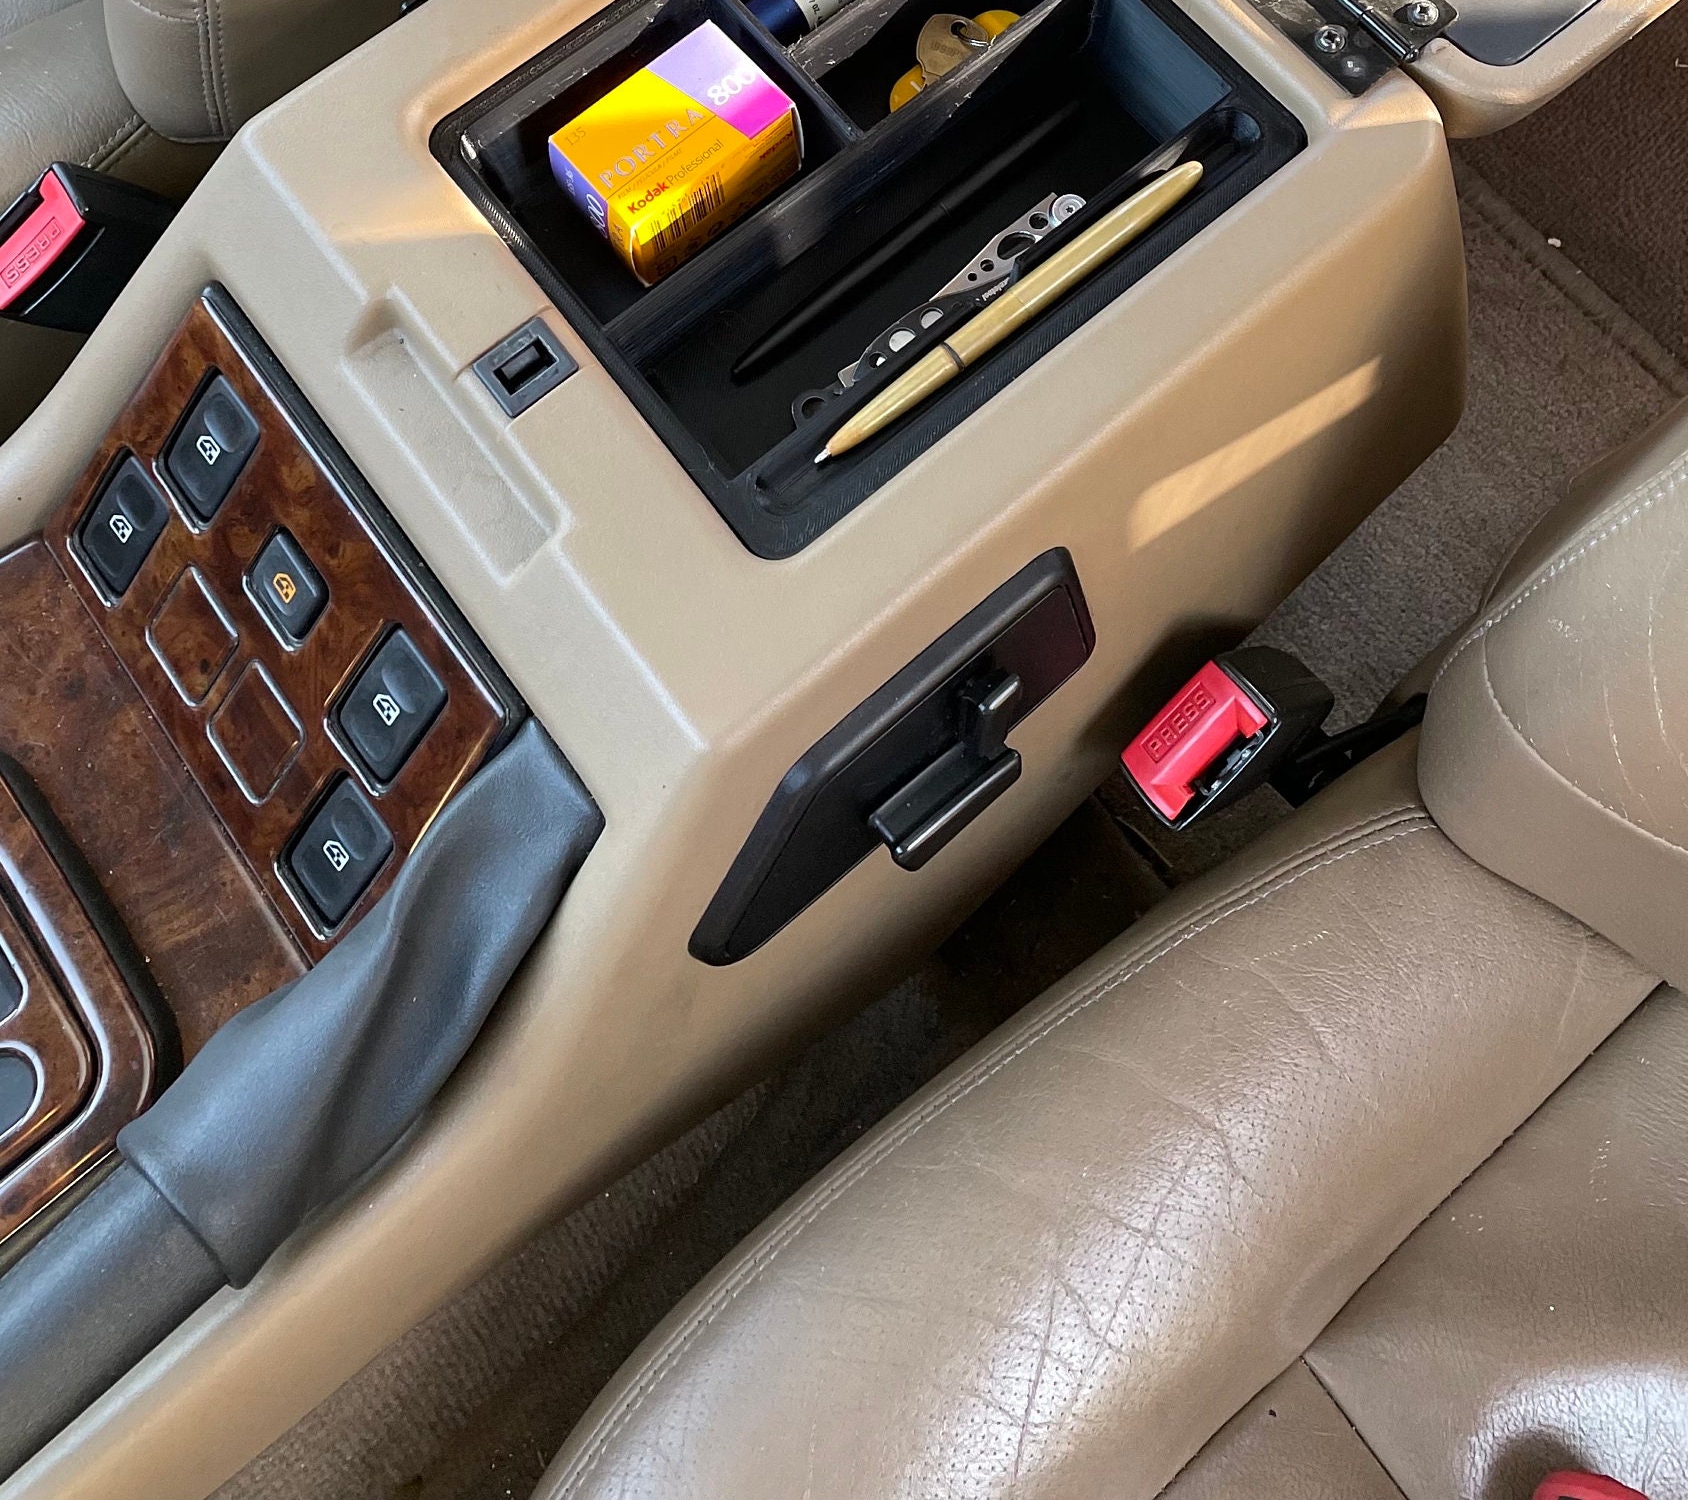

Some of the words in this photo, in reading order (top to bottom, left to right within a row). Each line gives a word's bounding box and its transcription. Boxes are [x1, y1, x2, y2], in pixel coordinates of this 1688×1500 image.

[707, 66, 757, 106] 800
[565, 126, 587, 146] 135
[598, 108, 704, 190] PORTRA
[627, 181, 670, 215] Kodak
[666, 139, 724, 187] Professional
[6, 222, 63, 285] PRESS
[1149, 690, 1211, 759] PRESS
